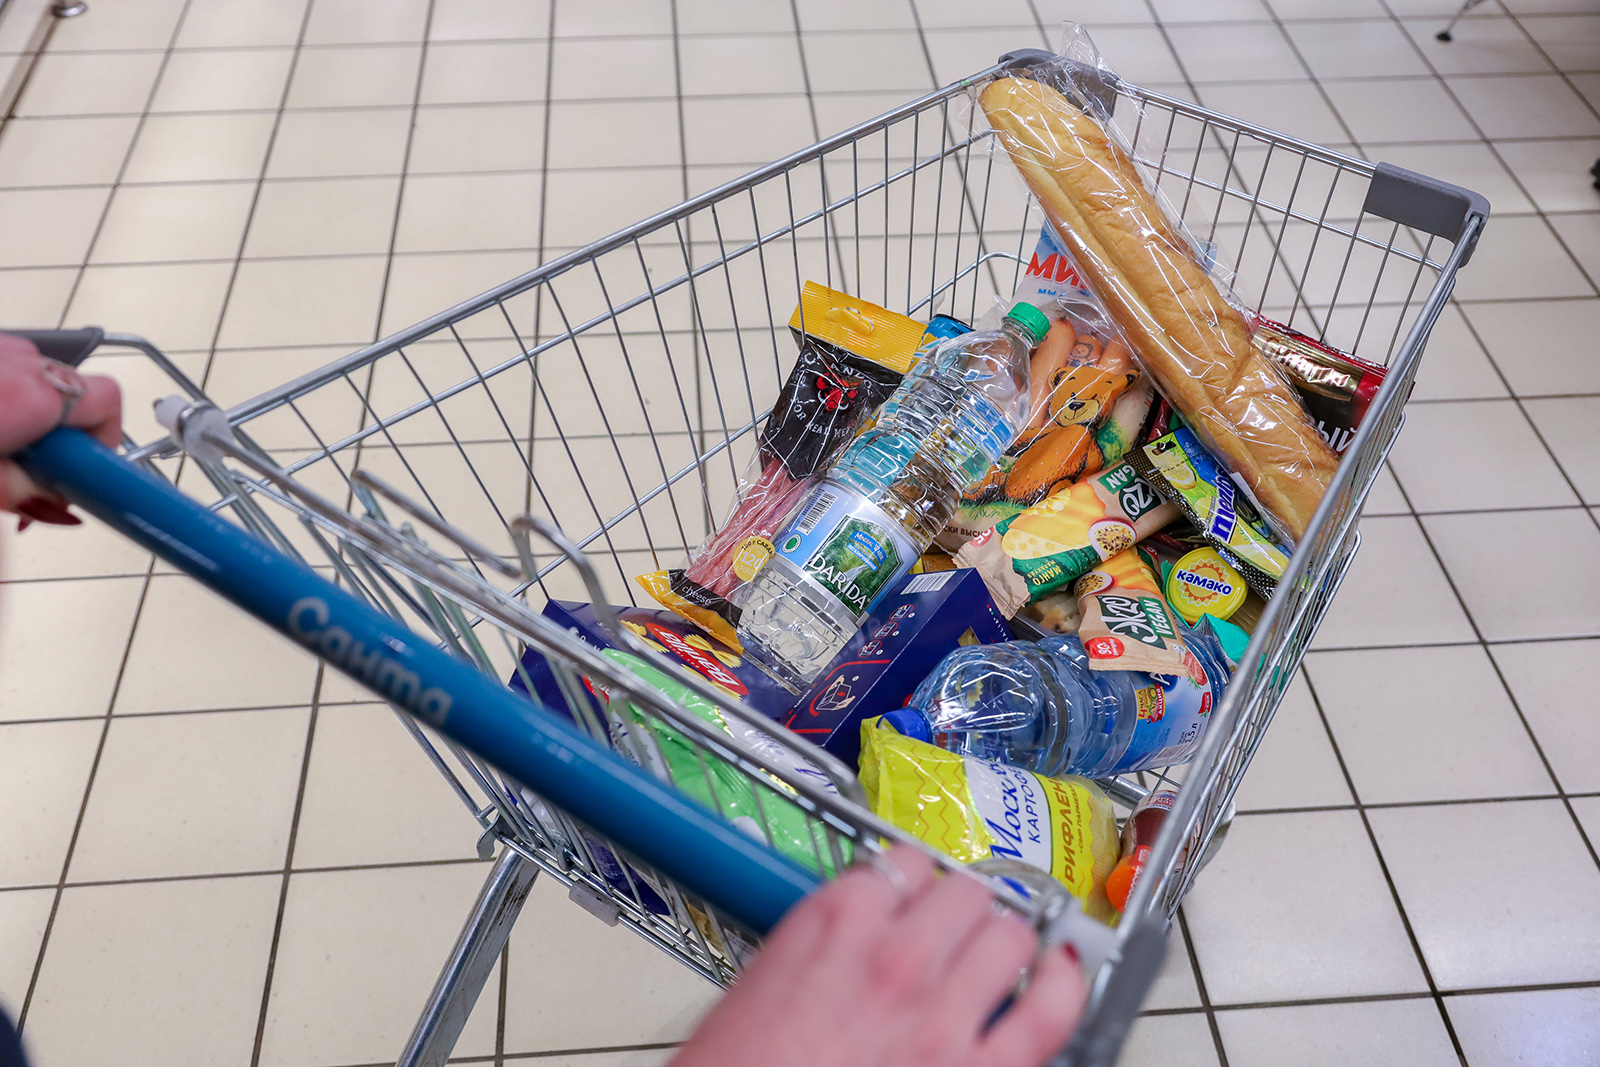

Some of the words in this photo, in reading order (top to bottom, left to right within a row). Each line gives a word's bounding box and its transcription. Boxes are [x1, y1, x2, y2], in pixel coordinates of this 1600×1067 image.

[1025, 251, 1087, 291] МИ
[808, 553, 868, 610] DARIDA
[1032, 564, 1062, 586] МАНГО
[681, 586, 712, 606] cheese
[1142, 599, 1173, 636] VEGAN
[659, 628, 740, 686] Barilla
[1155, 688, 1163, 715] АКЦИЯ
